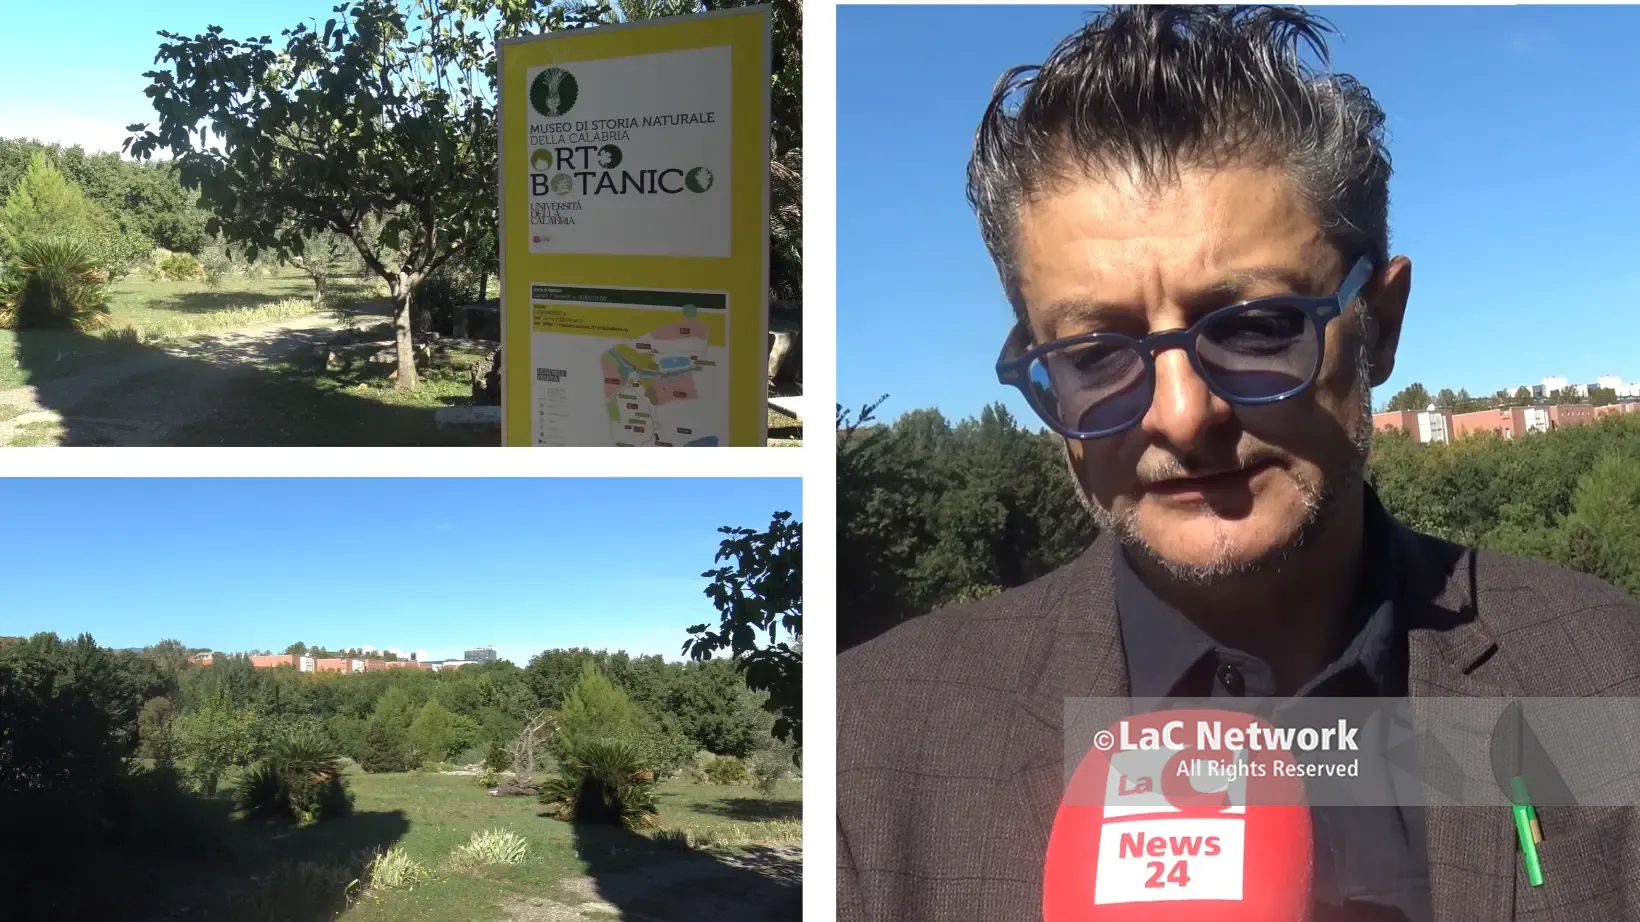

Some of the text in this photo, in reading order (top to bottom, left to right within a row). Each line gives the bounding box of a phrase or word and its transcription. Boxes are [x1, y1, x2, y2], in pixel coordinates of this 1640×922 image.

[530, 112, 715, 134] MUSEO DI STORIA NATURALE
[530, 130, 630, 146] DELLA CALABRIA
[530, 200, 582, 211] UNIVERSITÀ
[530, 216, 575, 225] CALABRIA
[1119, 831, 1221, 859] News
[1144, 860, 1191, 889] 24
